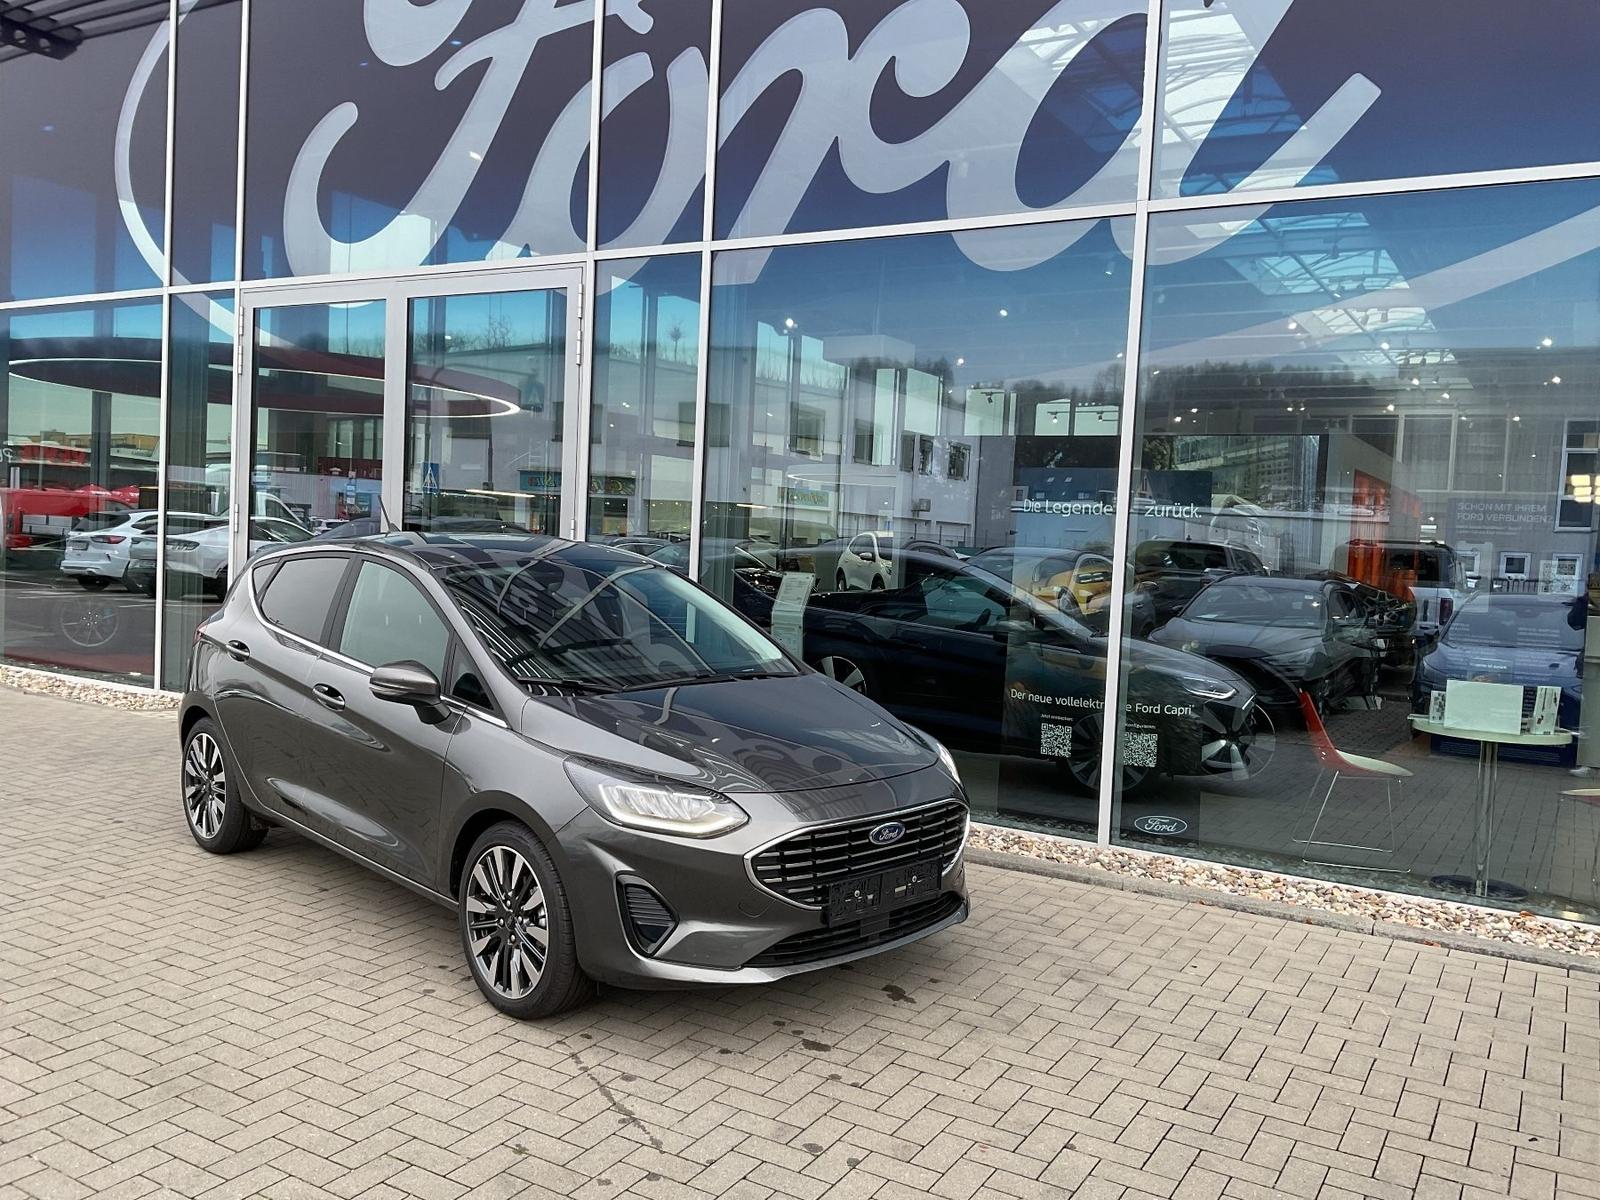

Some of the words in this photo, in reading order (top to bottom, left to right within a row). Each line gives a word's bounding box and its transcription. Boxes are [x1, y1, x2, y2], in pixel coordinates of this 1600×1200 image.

[282, 0, 1382, 307] Ford
[1023, 499, 1042, 513] Die
[1045, 500, 1114, 517] Legende
[1144, 503, 1203, 518] zurück.
[1457, 502, 1493, 511] SCHON
[1494, 503, 1512, 511] MIT
[1514, 504, 1547, 513] IHREM
[1457, 512, 1484, 521] FORD
[1010, 688, 1027, 700] Der
[1028, 693, 1052, 704] neue
[1135, 702, 1161, 714] Ford
[1144, 817, 1178, 832] Ford
[879, 826, 899, 841] Ford
